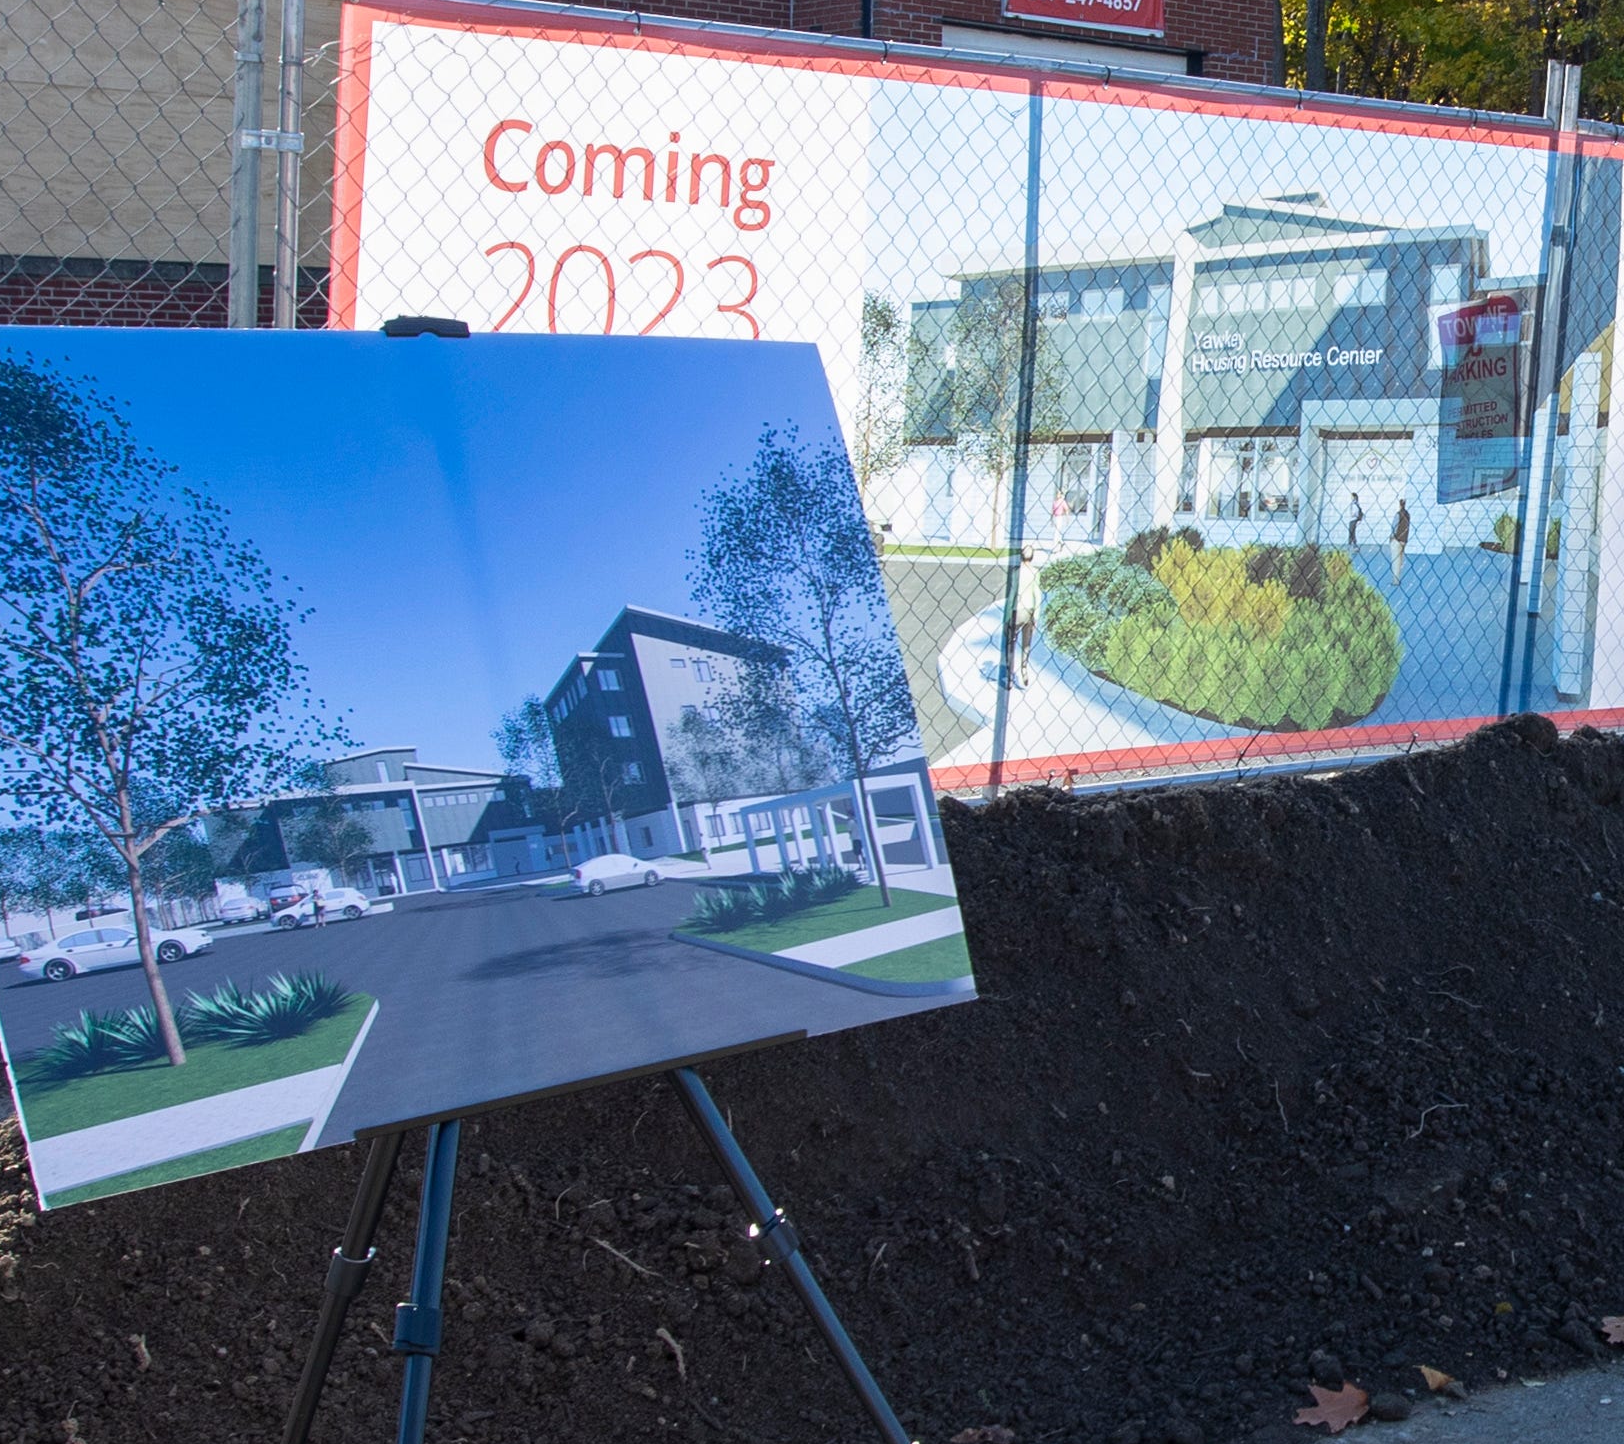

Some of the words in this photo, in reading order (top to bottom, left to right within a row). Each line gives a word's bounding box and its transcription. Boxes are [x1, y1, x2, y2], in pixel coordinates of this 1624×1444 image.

[483, 119, 776, 231] Coming
[484, 241, 759, 341] 2023
[1194, 331, 1246, 351] Yawkey
[1442, 316, 1483, 339] TOW
[1192, 354, 1247, 374] Housing
[1251, 349, 1322, 369] Resource
[1327, 346, 1383, 366] Center
